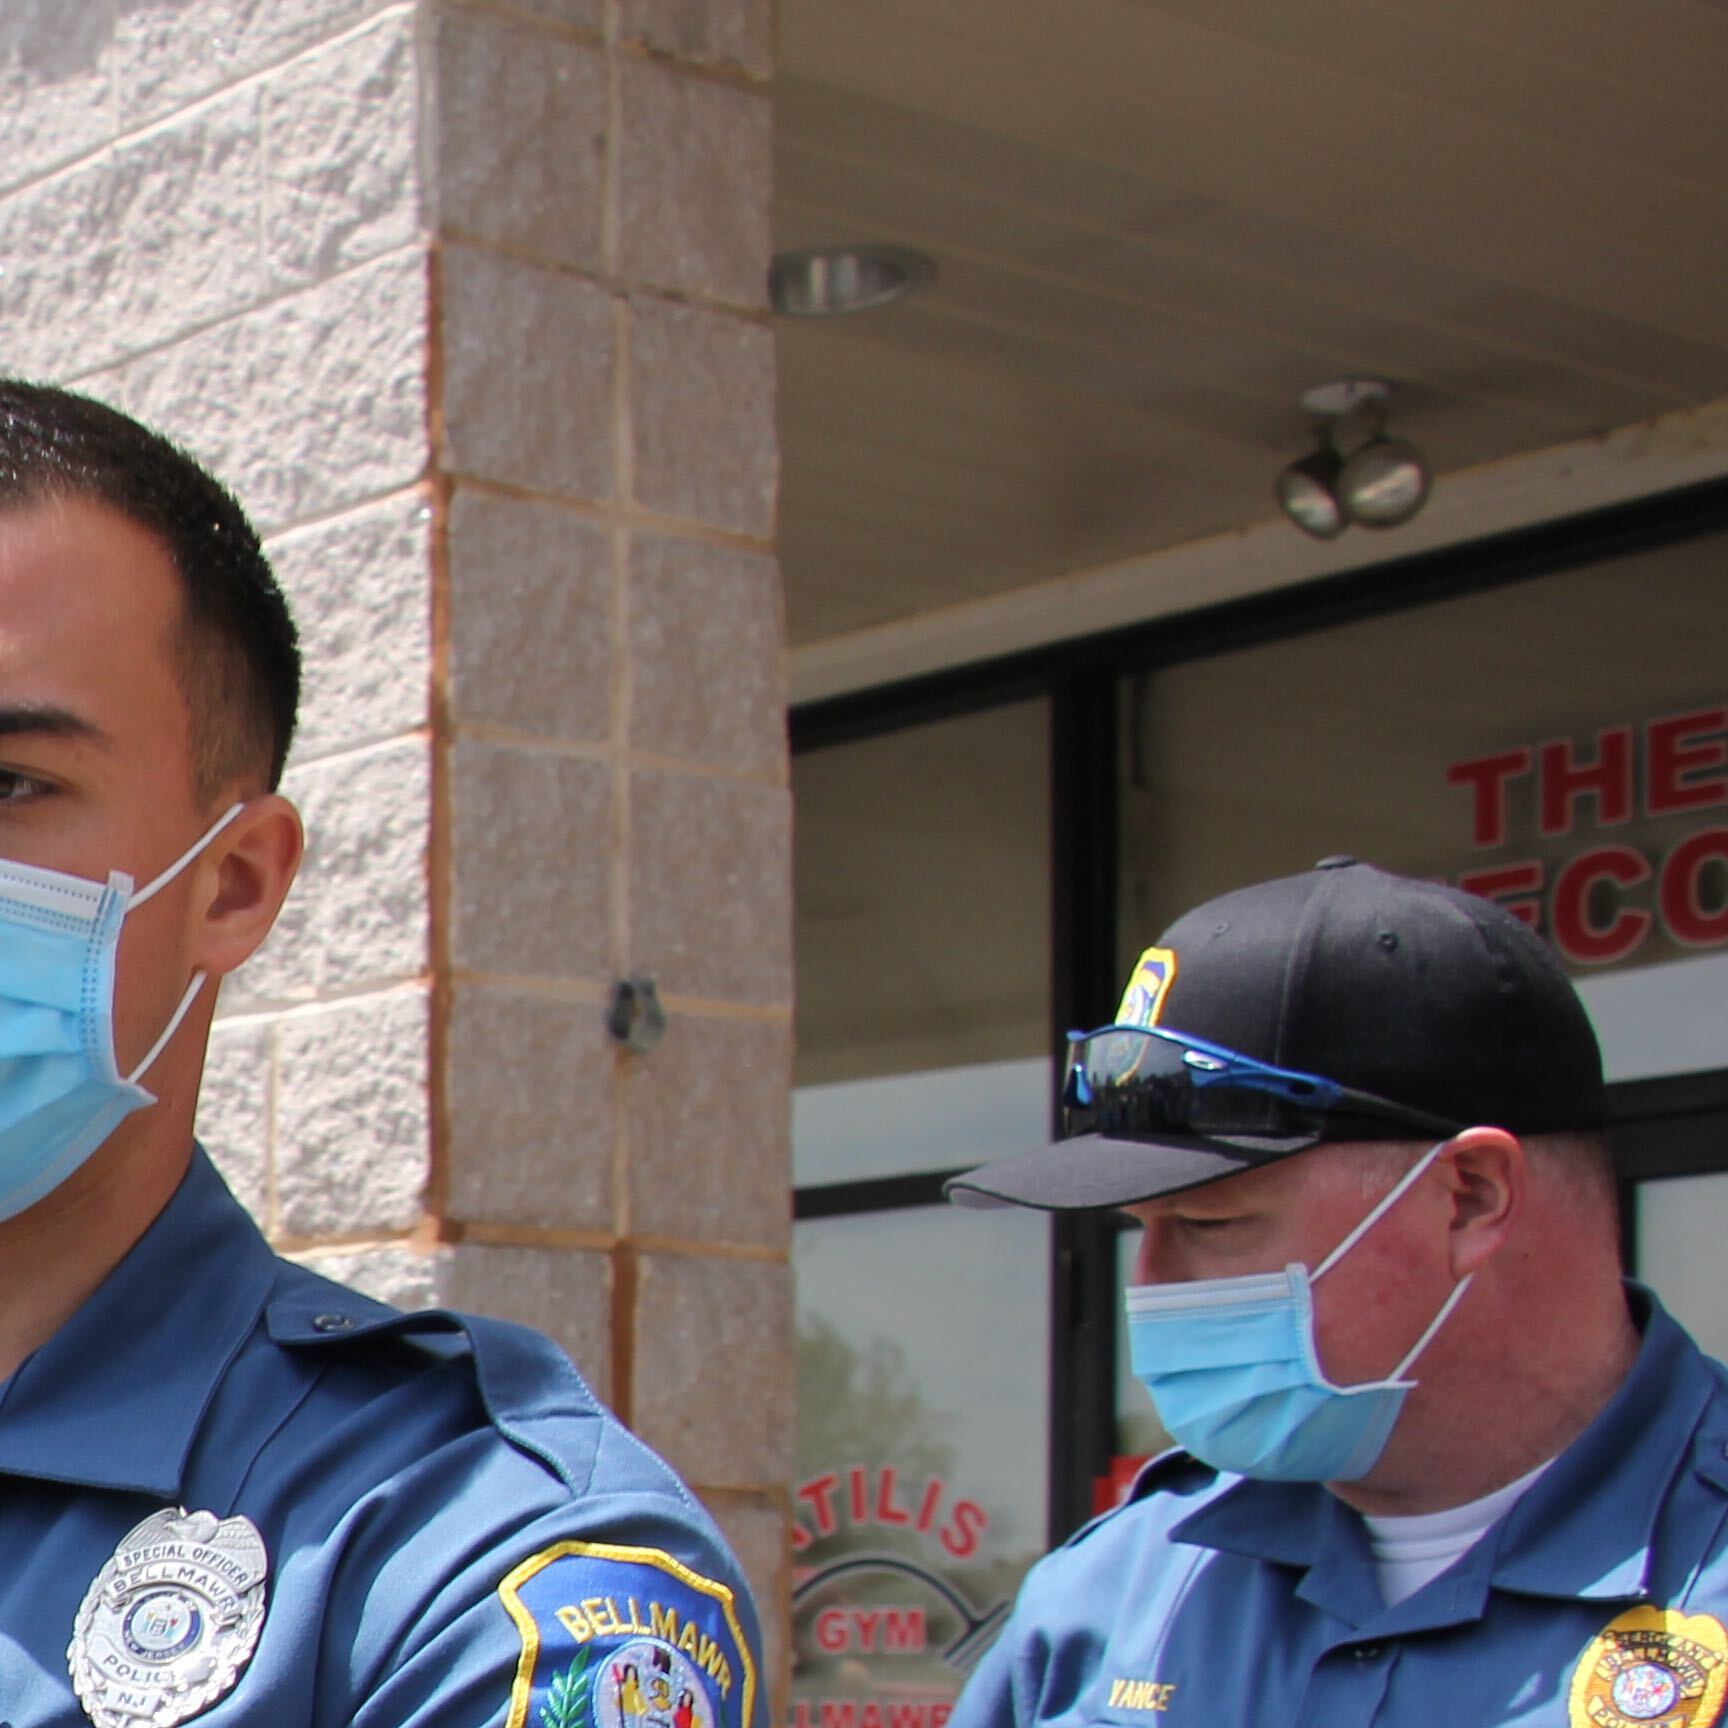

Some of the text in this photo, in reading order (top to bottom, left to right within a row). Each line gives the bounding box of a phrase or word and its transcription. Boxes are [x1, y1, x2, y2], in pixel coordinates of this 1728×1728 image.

[1445, 705, 1728, 849] THE
[792, 1466, 988, 1558] TILIS
[112, 1564, 237, 1613] BELLMAWR
[123, 1544, 249, 1586] SPECIAL OFFICER
[555, 1596, 732, 1699] BELLMAWR
[816, 1608, 927, 1651] GYM
